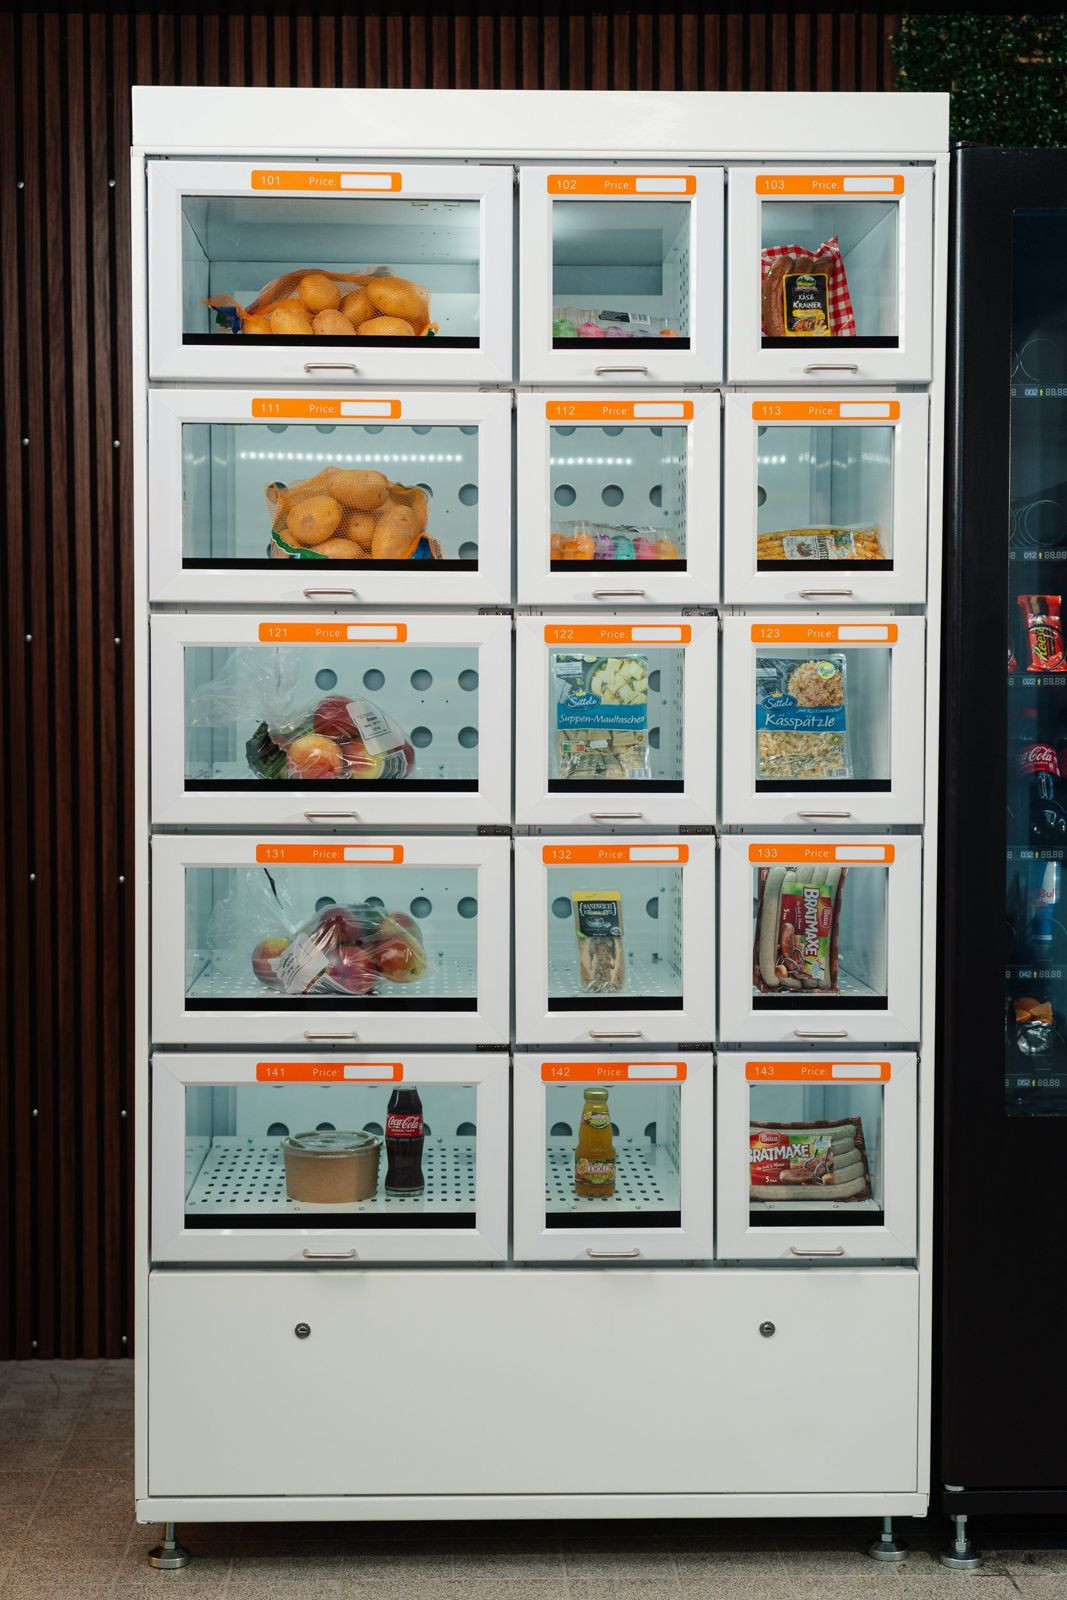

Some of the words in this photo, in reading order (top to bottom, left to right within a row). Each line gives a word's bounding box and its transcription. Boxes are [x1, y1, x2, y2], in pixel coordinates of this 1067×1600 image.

[261, 176, 280, 185] 101
[557, 179, 577, 190] 102
[765, 179, 785, 190] 103
[792, 300, 822, 309] KRAINER
[261, 403, 279, 412] 111
[556, 406, 575, 416] 112
[763, 406, 782, 416] 113
[1023, 552, 1037, 560] 012
[269, 628, 287, 637] 121
[554, 629, 574, 639] 122
[760, 629, 780, 638] 123
[765, 712, 836, 730] Kässpätzle
[266, 849, 284, 859] 131
[552, 850, 572, 859] 132
[758, 848, 778, 858] 133
[803, 887, 820, 957] BRATMAXE
[266, 1068, 285, 1077] 141
[551, 1067, 570, 1077] 142
[755, 1066, 774, 1076] 143
